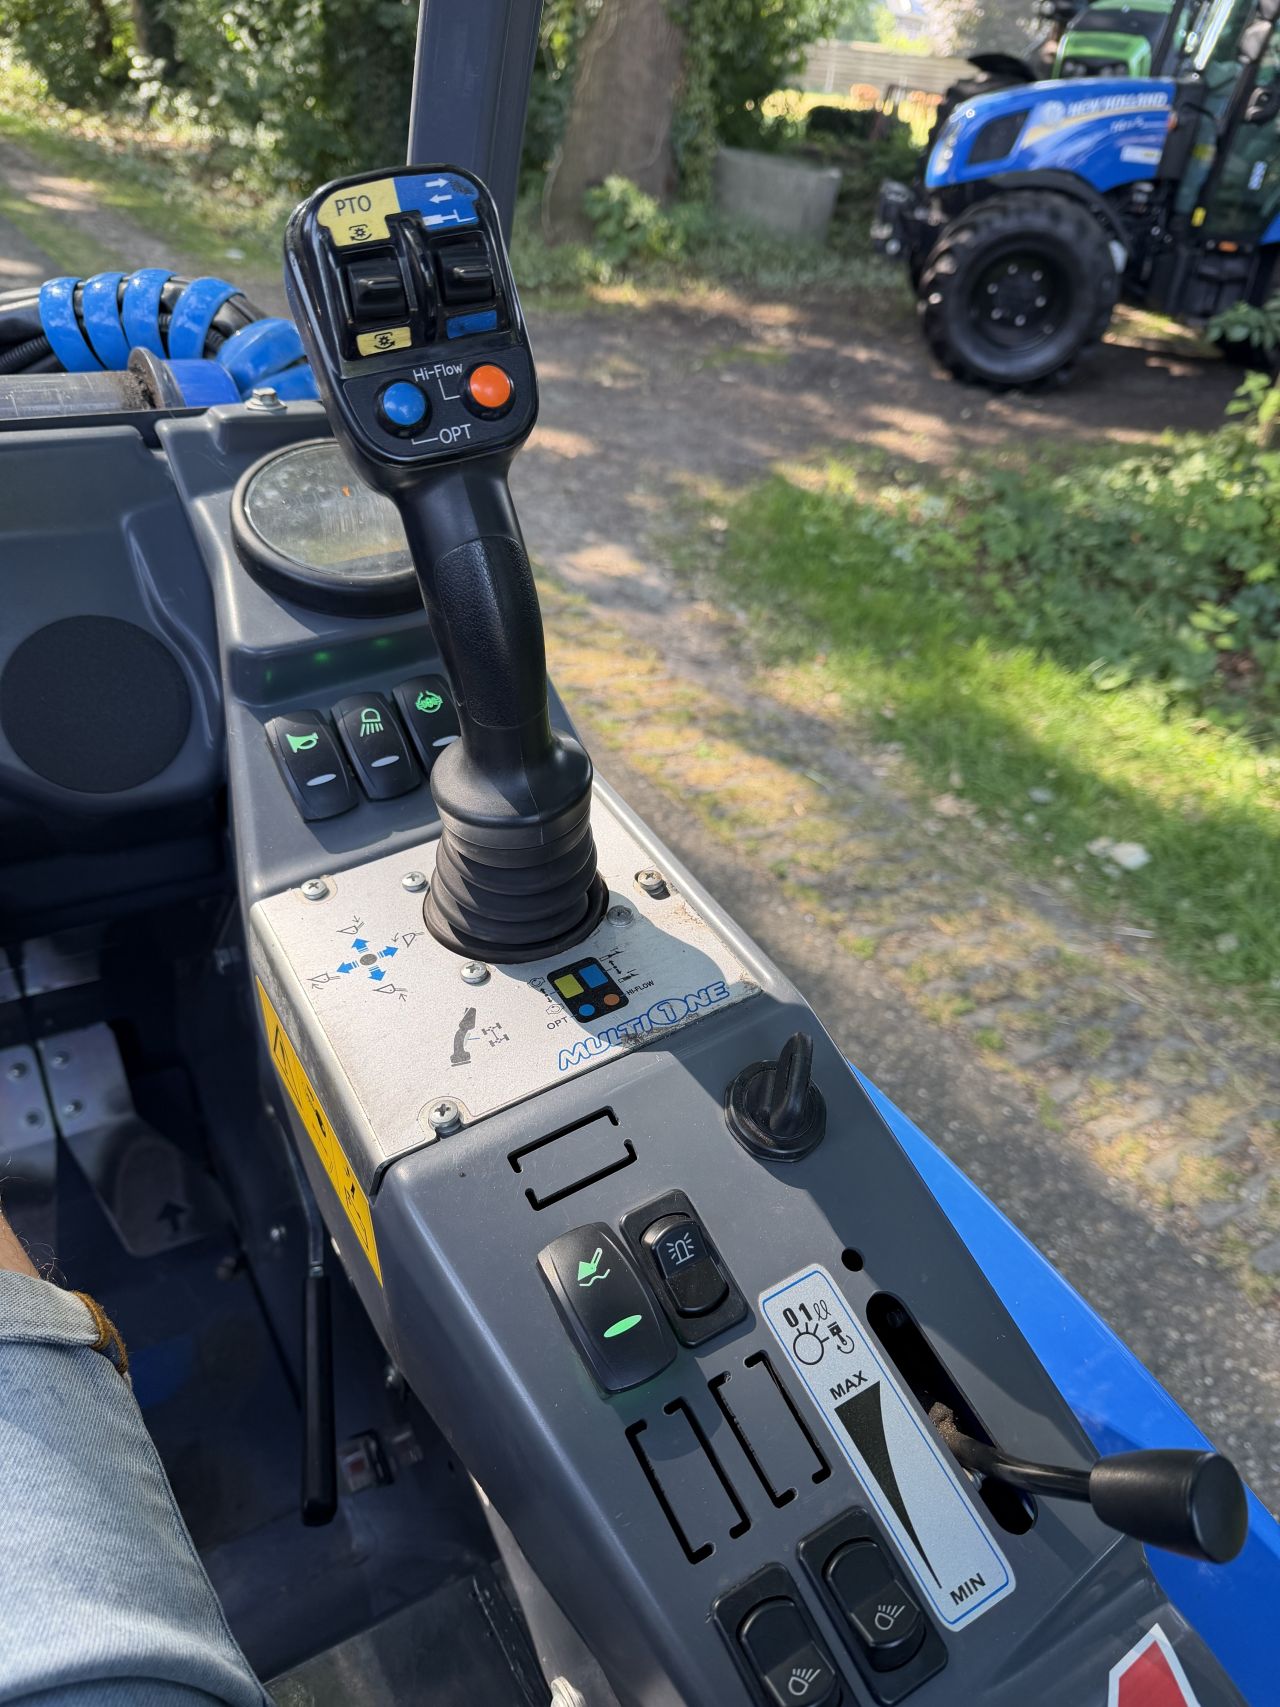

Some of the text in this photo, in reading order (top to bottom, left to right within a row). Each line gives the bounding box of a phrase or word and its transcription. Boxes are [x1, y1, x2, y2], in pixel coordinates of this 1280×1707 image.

[334, 195, 372, 217] PTO
[413, 363, 463, 382] Hi-Flow
[438, 423, 472, 444] OPT
[625, 980, 655, 996] HI-FLOW
[546, 1015, 568, 1031] OPT
[829, 1370, 868, 1401] MAX
[950, 1573, 986, 1606] MIN
